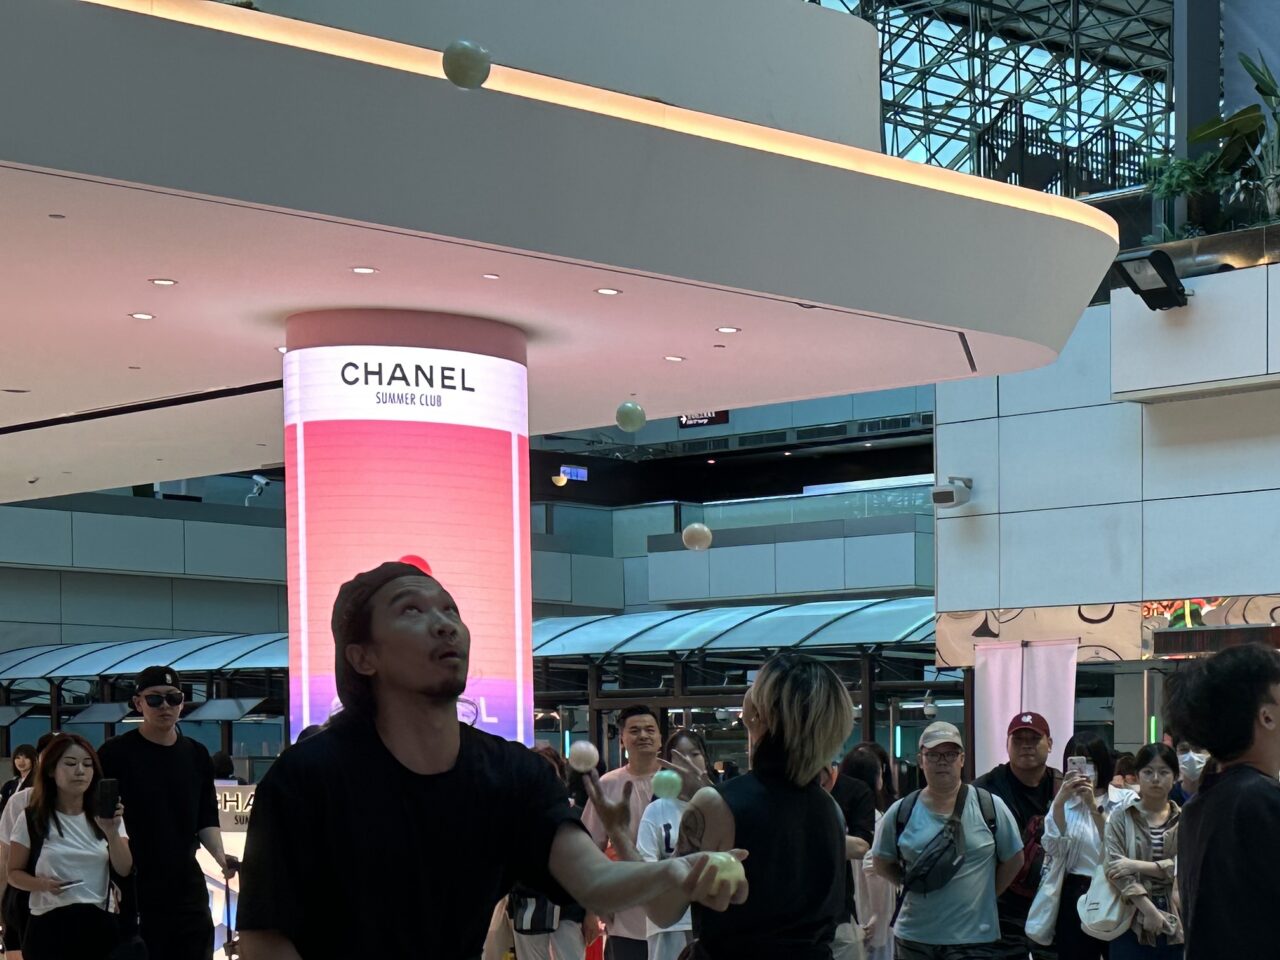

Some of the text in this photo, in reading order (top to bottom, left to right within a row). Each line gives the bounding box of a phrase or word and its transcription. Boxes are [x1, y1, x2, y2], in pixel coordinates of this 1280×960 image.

[341, 362, 475, 392] CHANEL
[376, 391, 442, 407] SUMMER CLUB
